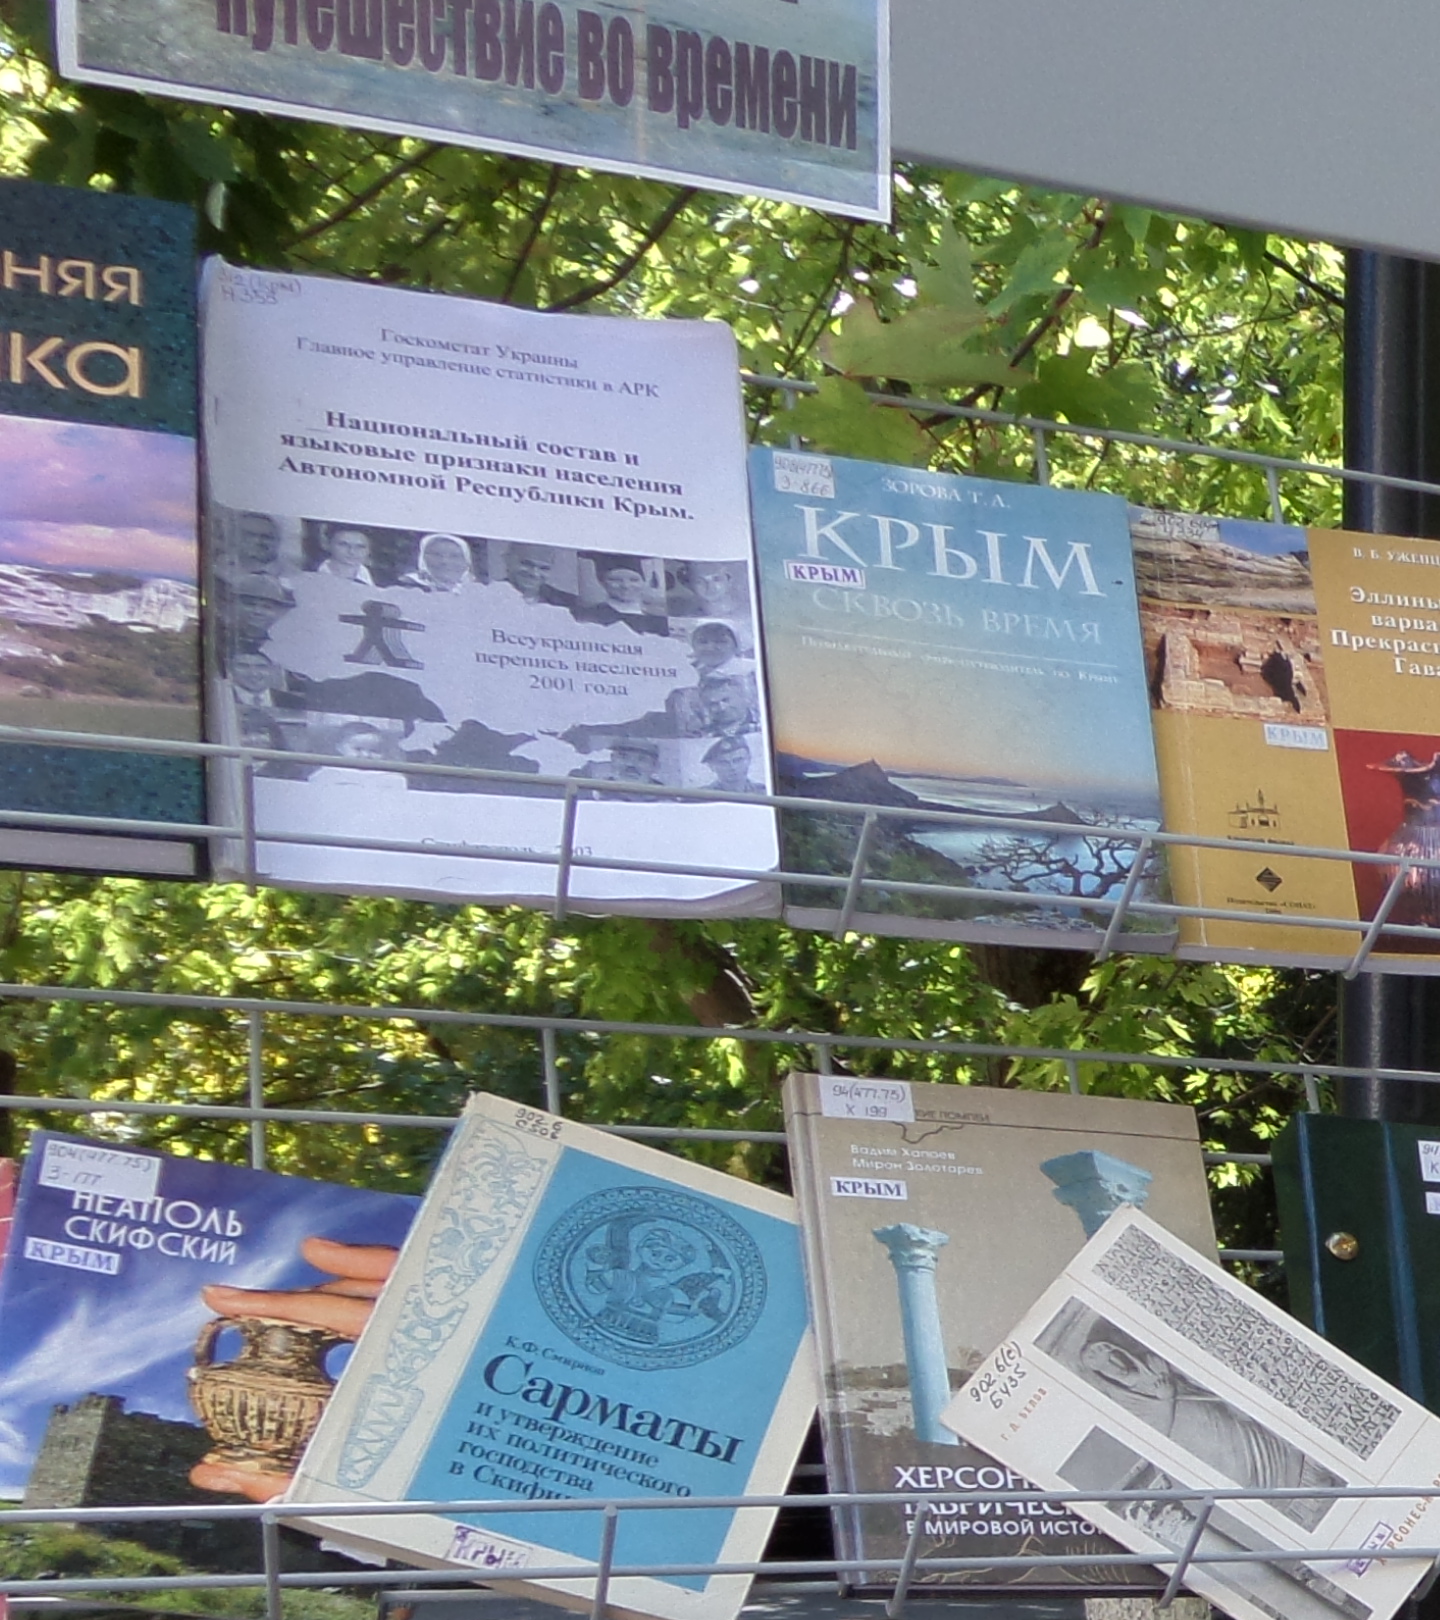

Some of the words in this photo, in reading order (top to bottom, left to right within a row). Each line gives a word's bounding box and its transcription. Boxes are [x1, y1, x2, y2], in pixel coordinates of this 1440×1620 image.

[576, 10, 635, 108] во
[646, 23, 857, 151] времени
[297, 336, 375, 361] Главное
[380, 350, 492, 378] управление
[496, 366, 597, 392] статистики
[619, 380, 660, 399] АРК
[380, 327, 491, 358] Госкомстат
[496, 344, 579, 371] Украины
[325, 410, 528, 452] Национальный
[536, 438, 617, 465] состав
[278, 455, 447, 492] Автономной
[455, 476, 606, 512] Республики
[613, 496, 695, 521] Крым.
[280, 433, 417, 463] языковые
[424, 451, 548, 481] признаки
[555, 466, 683, 496] населения
[792, 565, 859, 583] КРЫМ
[794, 503, 1107, 597] КРЫМ
[811, 587, 964, 628] СКВОЗЬ
[982, 608, 1101, 645] ВРЕМЯ
[491, 628, 643, 657] Всеукраинская
[530, 675, 577, 693] 2001
[583, 680, 628, 697] года
[576, 659, 678, 679] населения
[850, 1144, 897, 1157] Вадим
[852, 1157, 903, 1171] Мирон
[907, 1160, 984, 1176] Золотарев
[834, 1179, 902, 1198] КРЫМ
[30, 1240, 114, 1272] КРЫМ
[65, 1215, 238, 1266] СКИФСКИЙ
[483, 1353, 745, 1466] Сарматы
[466, 1420, 500, 1441] их
[506, 1433, 692, 1498] политического
[494, 1409, 660, 1469] утверждение
[456, 1440, 595, 1492] господства
[926, 1519, 1034, 1535] МИРОВОЙ
